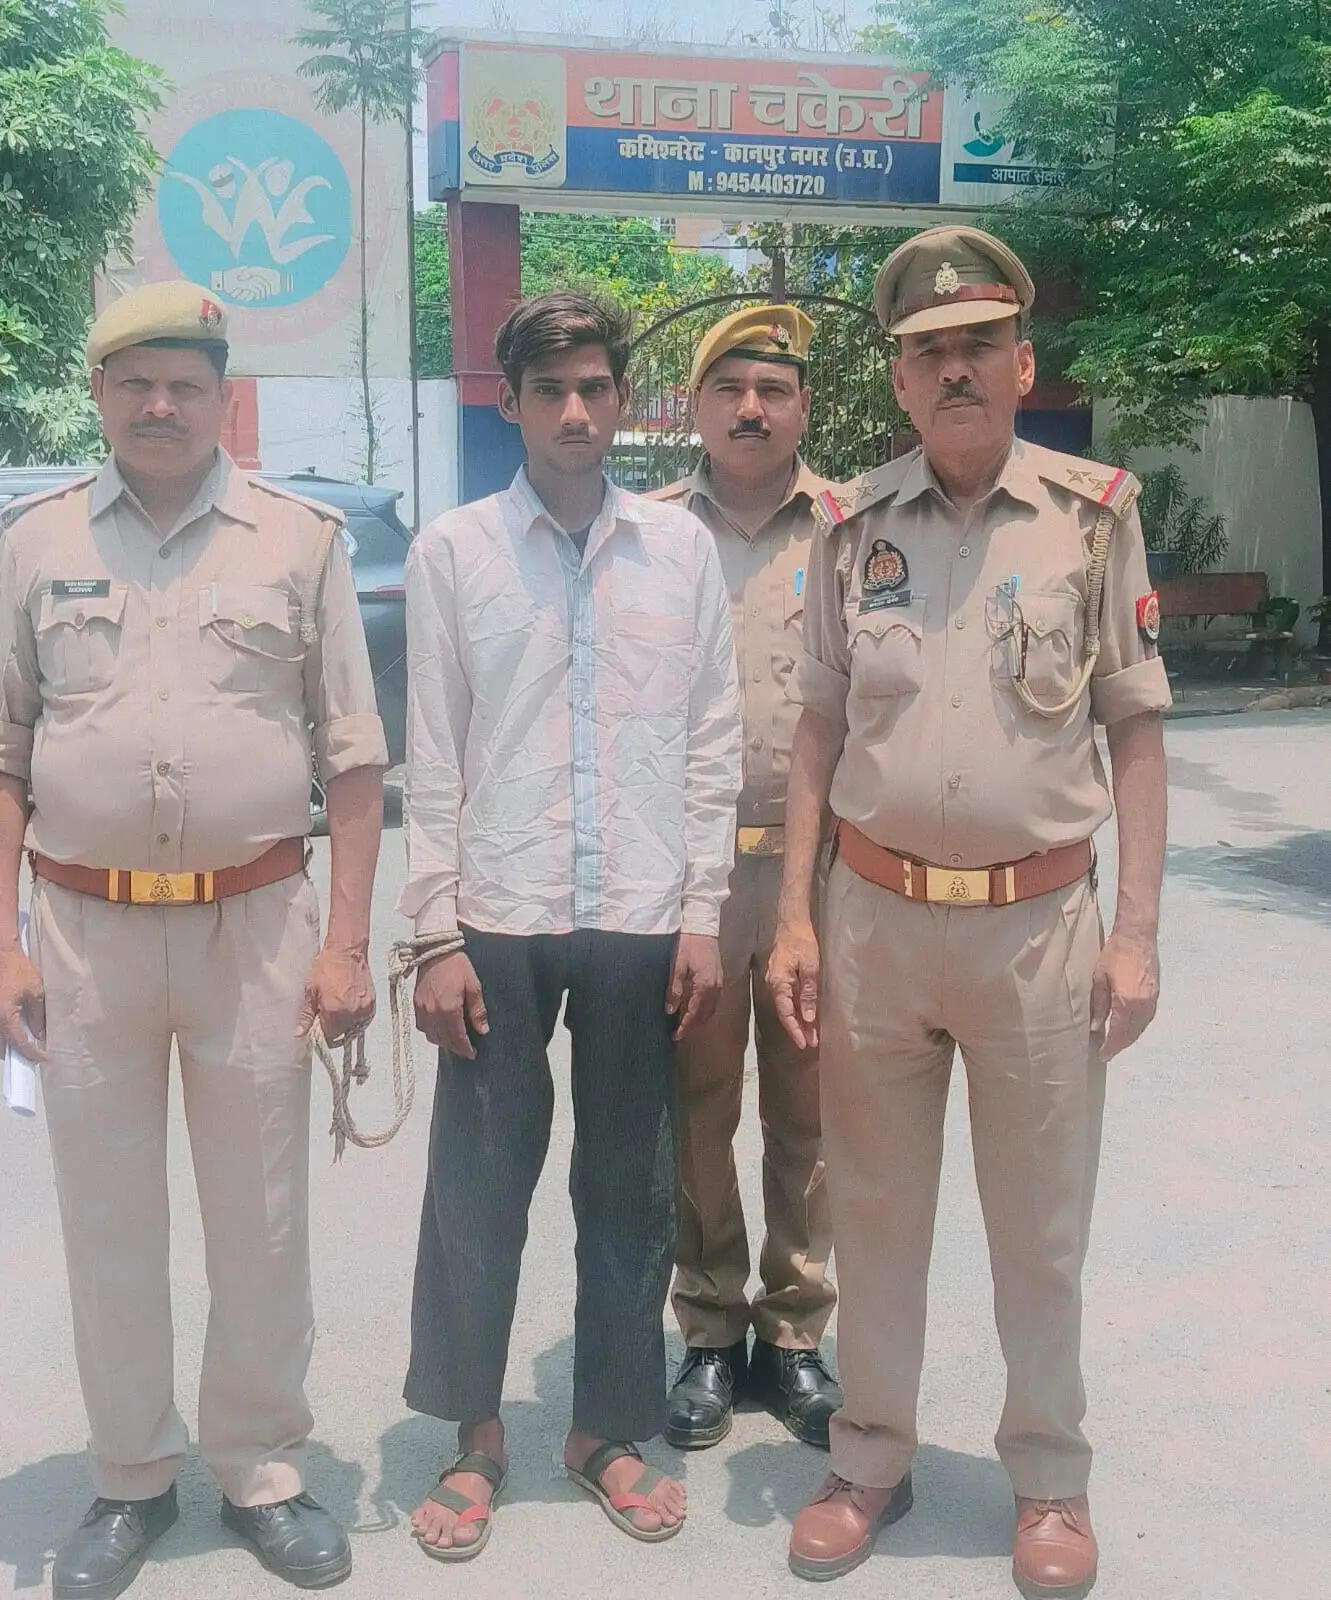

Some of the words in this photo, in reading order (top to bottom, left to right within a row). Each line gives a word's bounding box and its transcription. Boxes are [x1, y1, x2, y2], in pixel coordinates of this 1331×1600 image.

[584, 76, 738, 130] थाना
[749, 71, 928, 139] चकेरी
[722, 143, 787, 171] कानपुर
[789, 146, 829, 167] नगर
